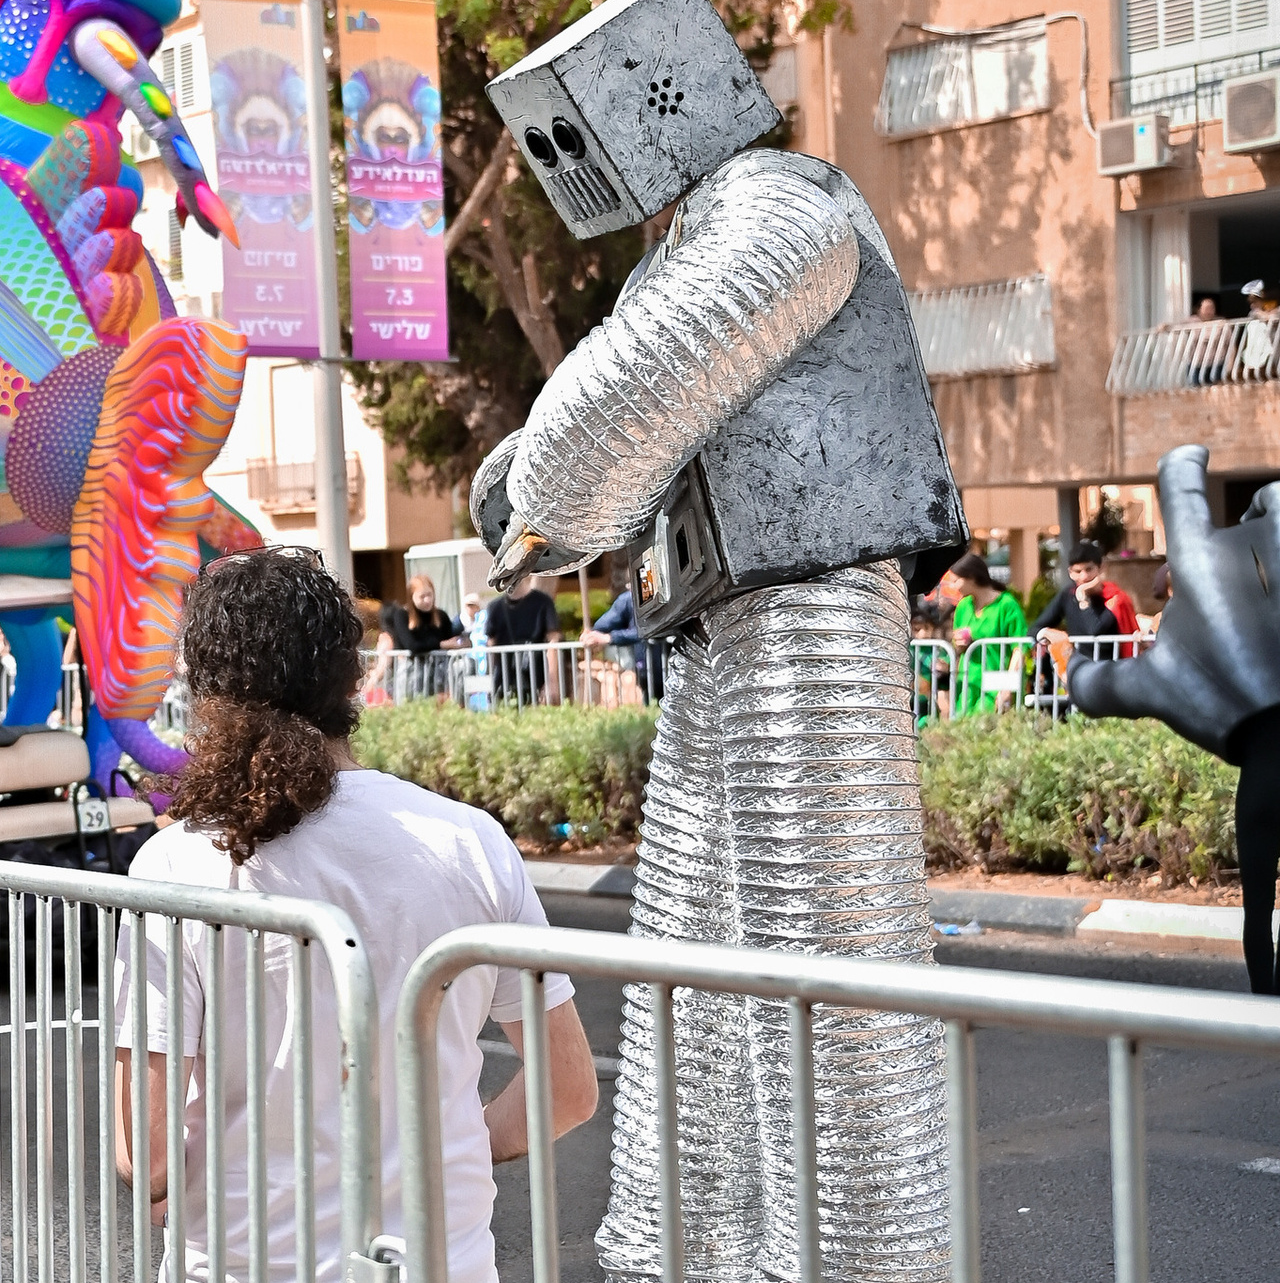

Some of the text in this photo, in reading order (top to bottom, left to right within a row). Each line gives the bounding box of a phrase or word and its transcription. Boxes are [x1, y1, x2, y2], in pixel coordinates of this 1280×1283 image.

[351, 164, 438, 184] העדלאידע
[370, 254, 423, 272] פורים
[385, 288, 414, 306] 7.3
[369, 320, 431, 340] שלישי
[86, 811, 104, 827] 29
